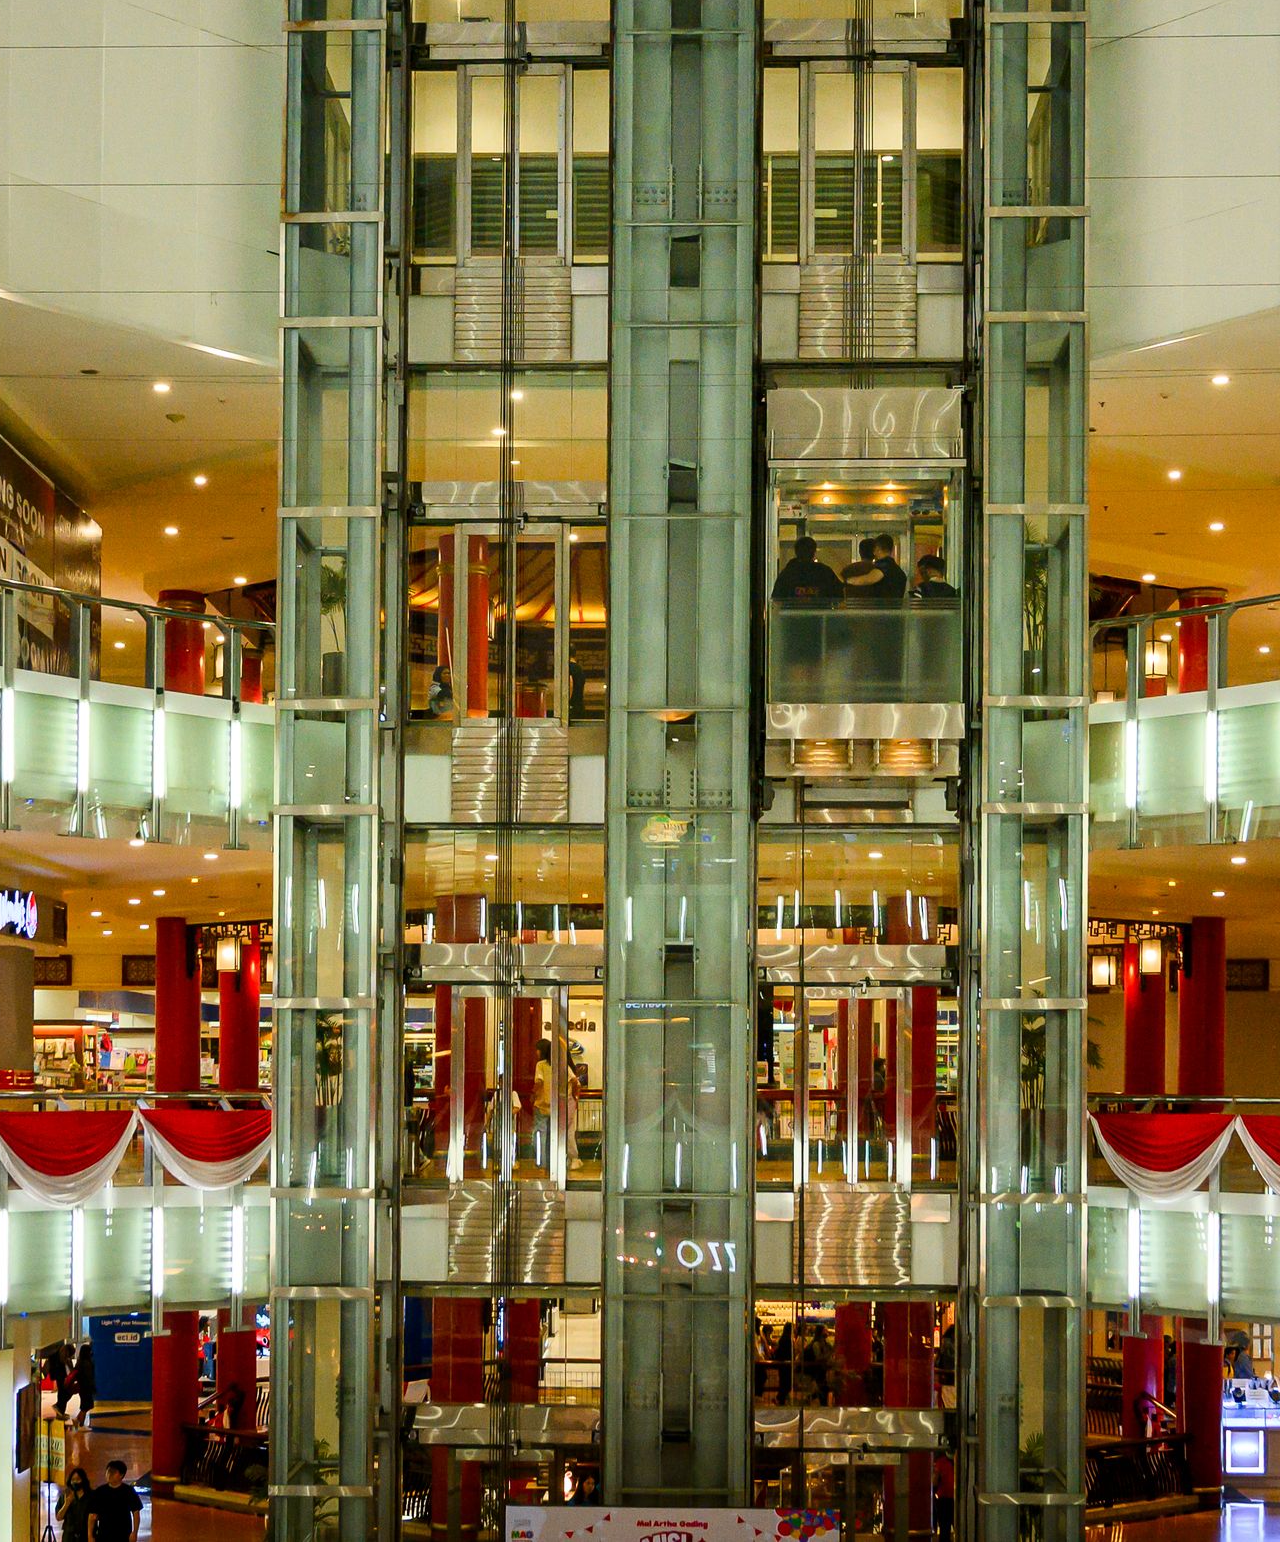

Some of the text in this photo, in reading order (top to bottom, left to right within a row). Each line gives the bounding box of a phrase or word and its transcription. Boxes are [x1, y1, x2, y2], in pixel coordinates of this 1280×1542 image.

[16, 492, 45, 538] SOON
[636, 1519, 709, 1529] Mal Artha Gading
